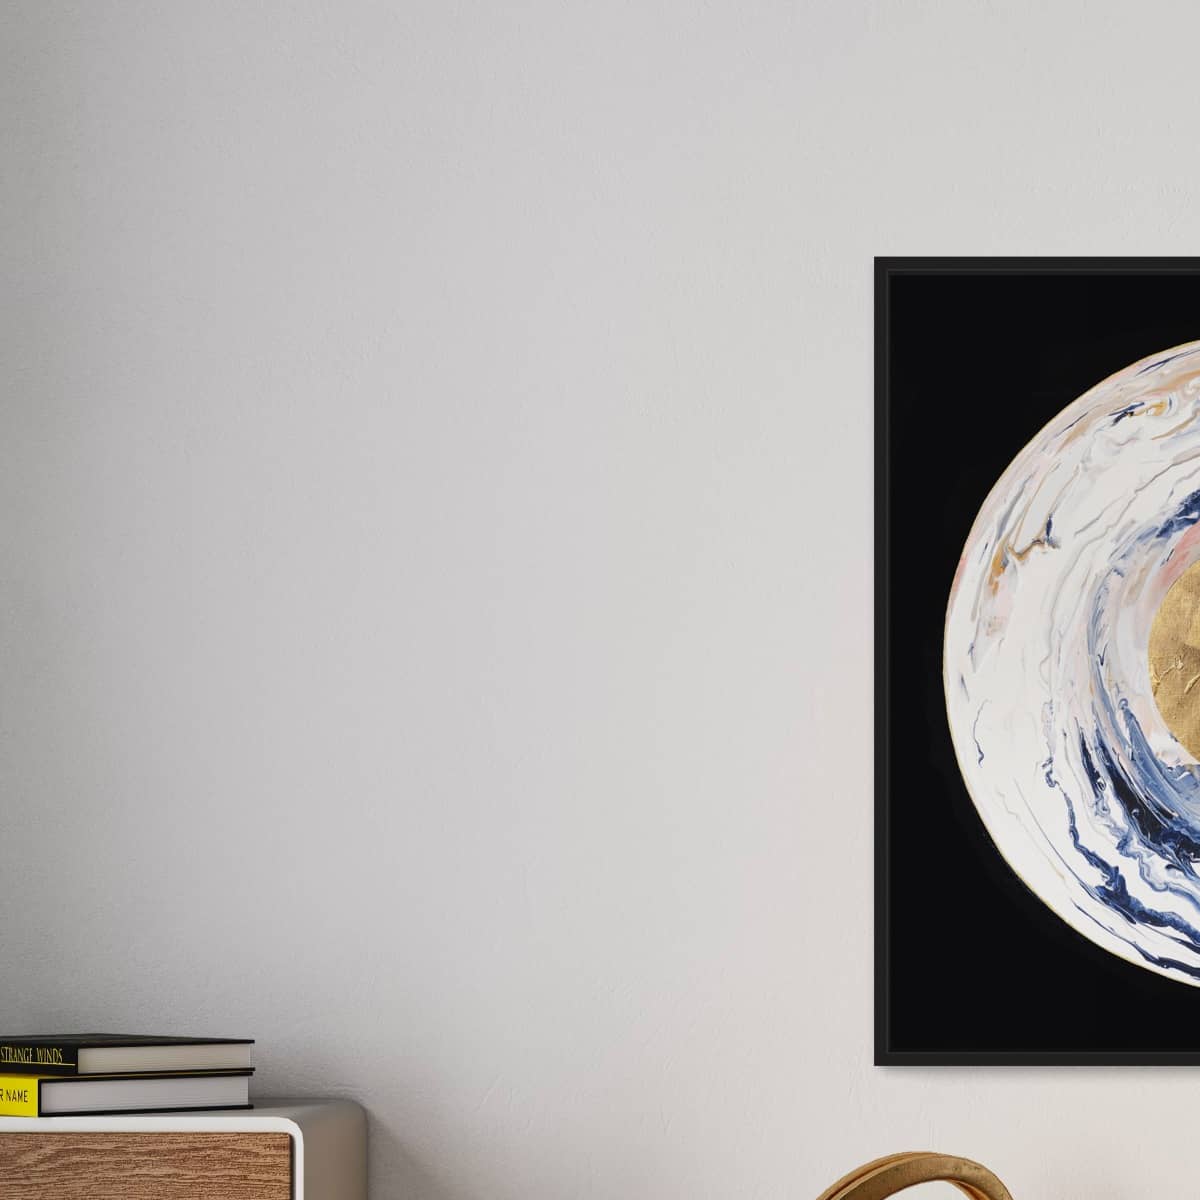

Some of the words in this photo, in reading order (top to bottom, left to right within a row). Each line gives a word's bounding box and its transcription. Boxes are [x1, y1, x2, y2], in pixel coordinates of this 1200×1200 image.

[0, 1046, 33, 1063] STRANGE
[36, 1047, 63, 1063] WINDS
[6, 1089, 29, 1103] NAME
